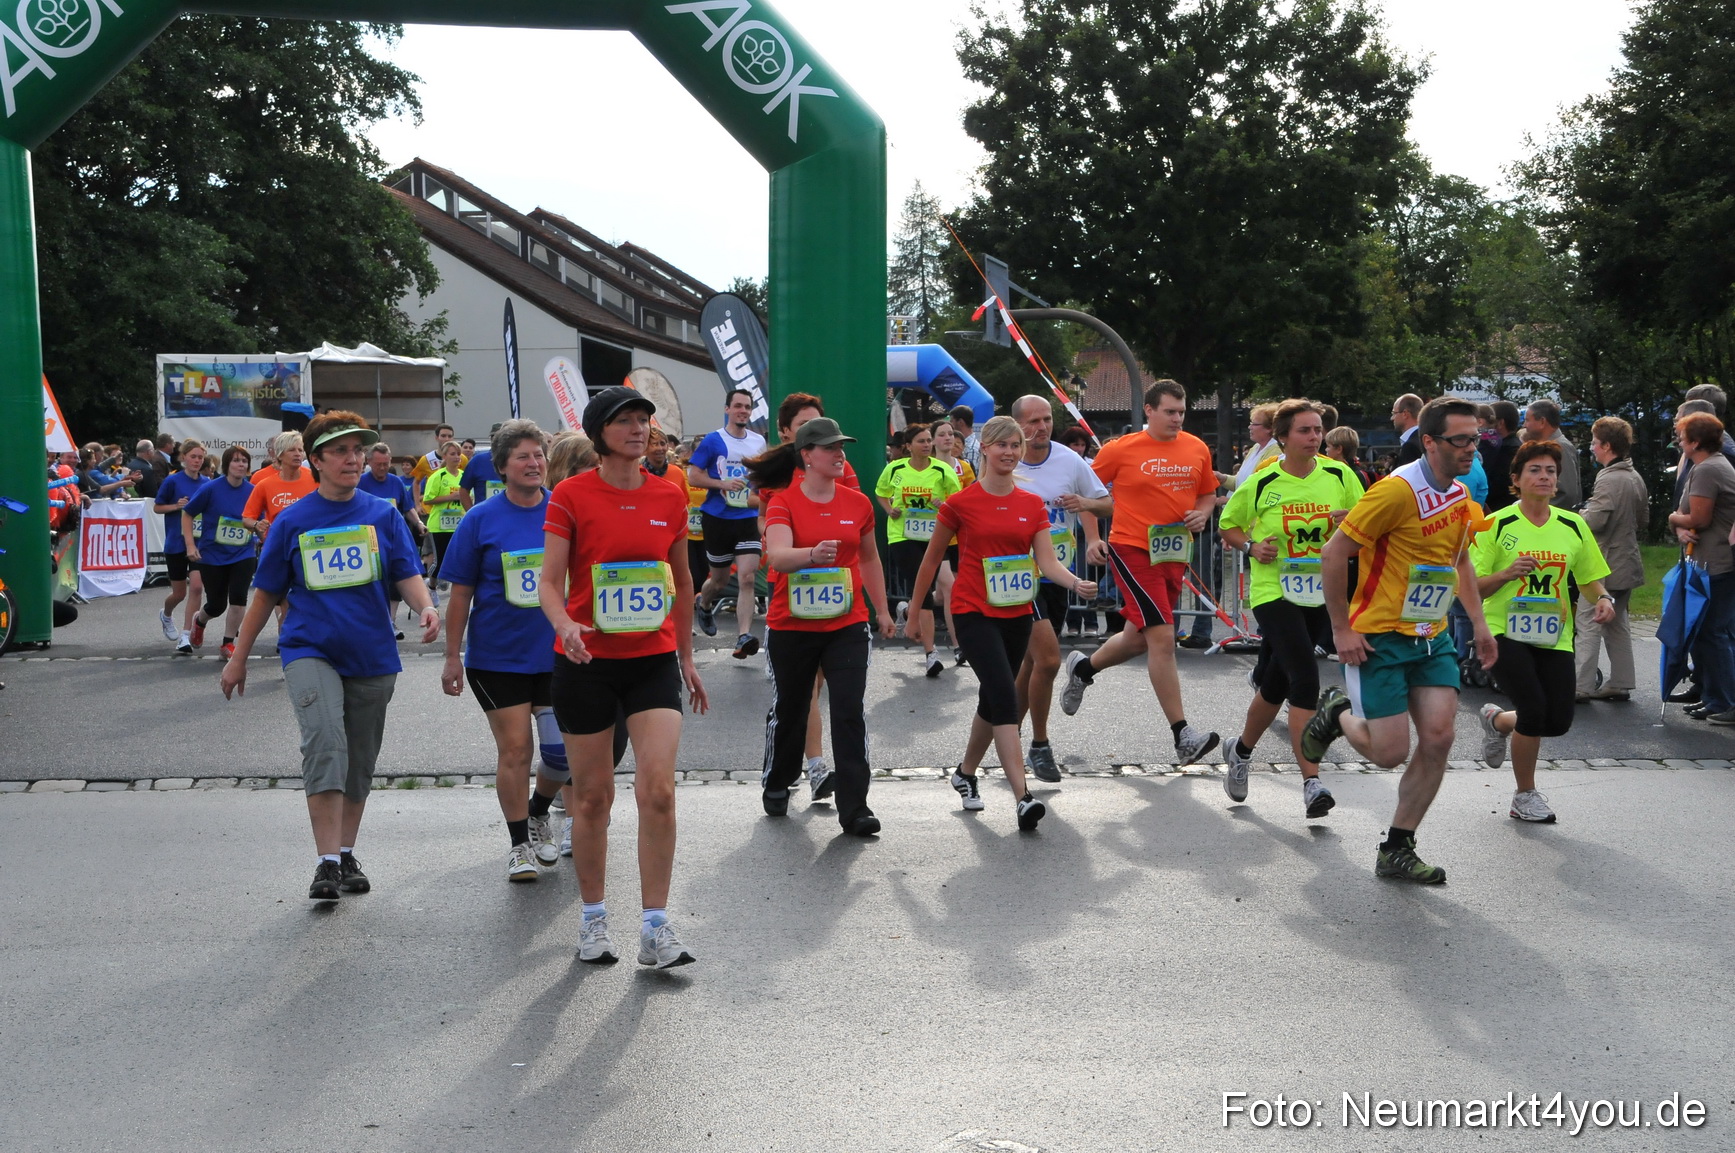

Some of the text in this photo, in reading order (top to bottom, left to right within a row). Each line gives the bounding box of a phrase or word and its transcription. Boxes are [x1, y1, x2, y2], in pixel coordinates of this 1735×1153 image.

[0, 0, 124, 118] AO
[664, 0, 840, 143] AOK
[169, 376, 288, 403] TLA Logistics
[1150, 461, 1192, 473] Fischer
[1282, 502, 1331, 515] Müller
[440, 516, 461, 525] 1312
[905, 519, 936, 533] 1315
[1422, 516, 1449, 537] MAX
[221, 526, 244, 540] 153
[1295, 527, 1322, 544] M
[86, 523, 140, 567] MEIER
[1151, 535, 1183, 554] 996
[311, 545, 363, 574] 148
[1517, 550, 1567, 561] Müller
[521, 569, 541, 592] 8
[989, 572, 1033, 593] 1146
[1281, 575, 1323, 594] 1314
[1527, 574, 1553, 595] M
[598, 586, 664, 614] 1153
[792, 585, 844, 605] 1145
[1407, 584, 1448, 608] 427
[1508, 614, 1559, 635] 1316
